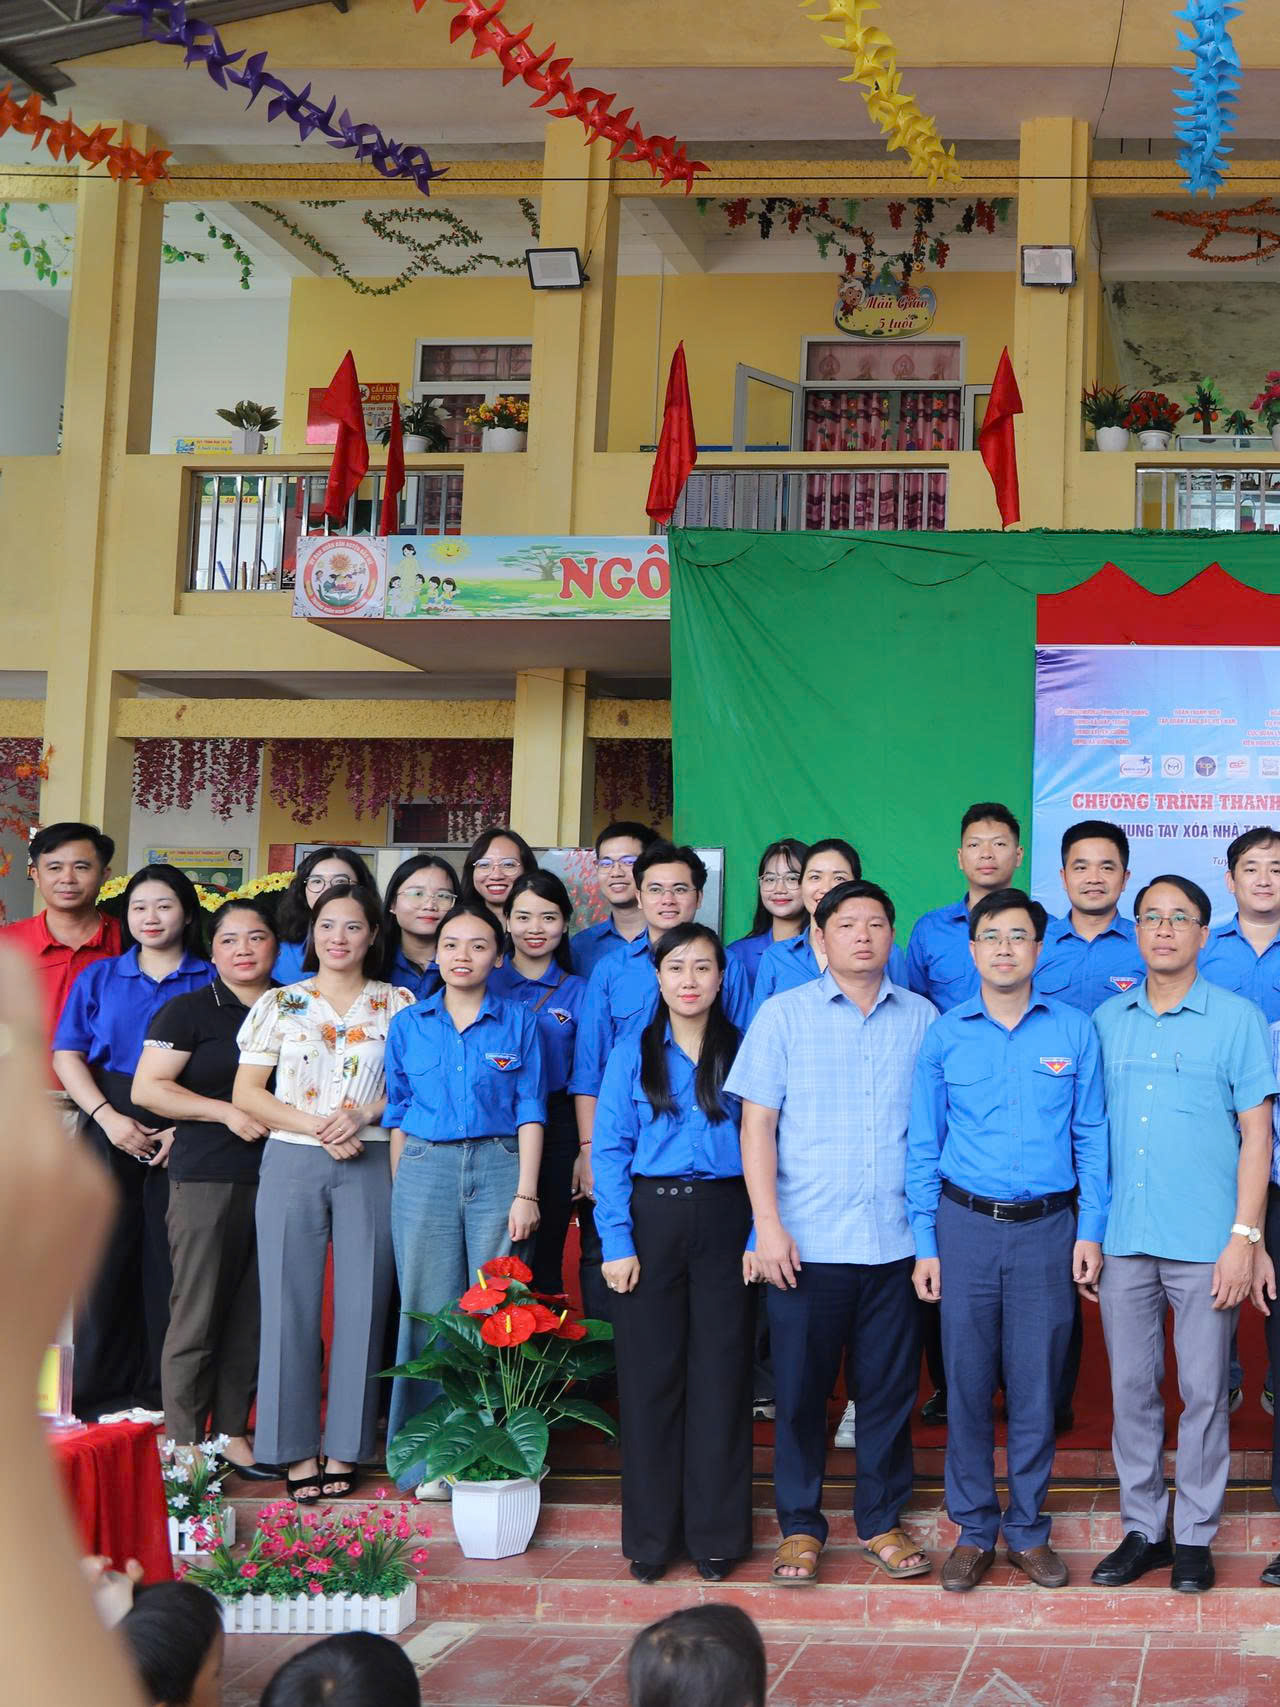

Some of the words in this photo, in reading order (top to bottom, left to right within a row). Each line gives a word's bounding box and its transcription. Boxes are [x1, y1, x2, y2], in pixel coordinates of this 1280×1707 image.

[1072, 792, 1149, 811] CHƯƠNG
[1154, 790, 1213, 811] TRÌNH
[1158, 824, 1179, 838] TAY
[1183, 822, 1209, 838] XÓA
[1213, 822, 1239, 838] NHÀ
